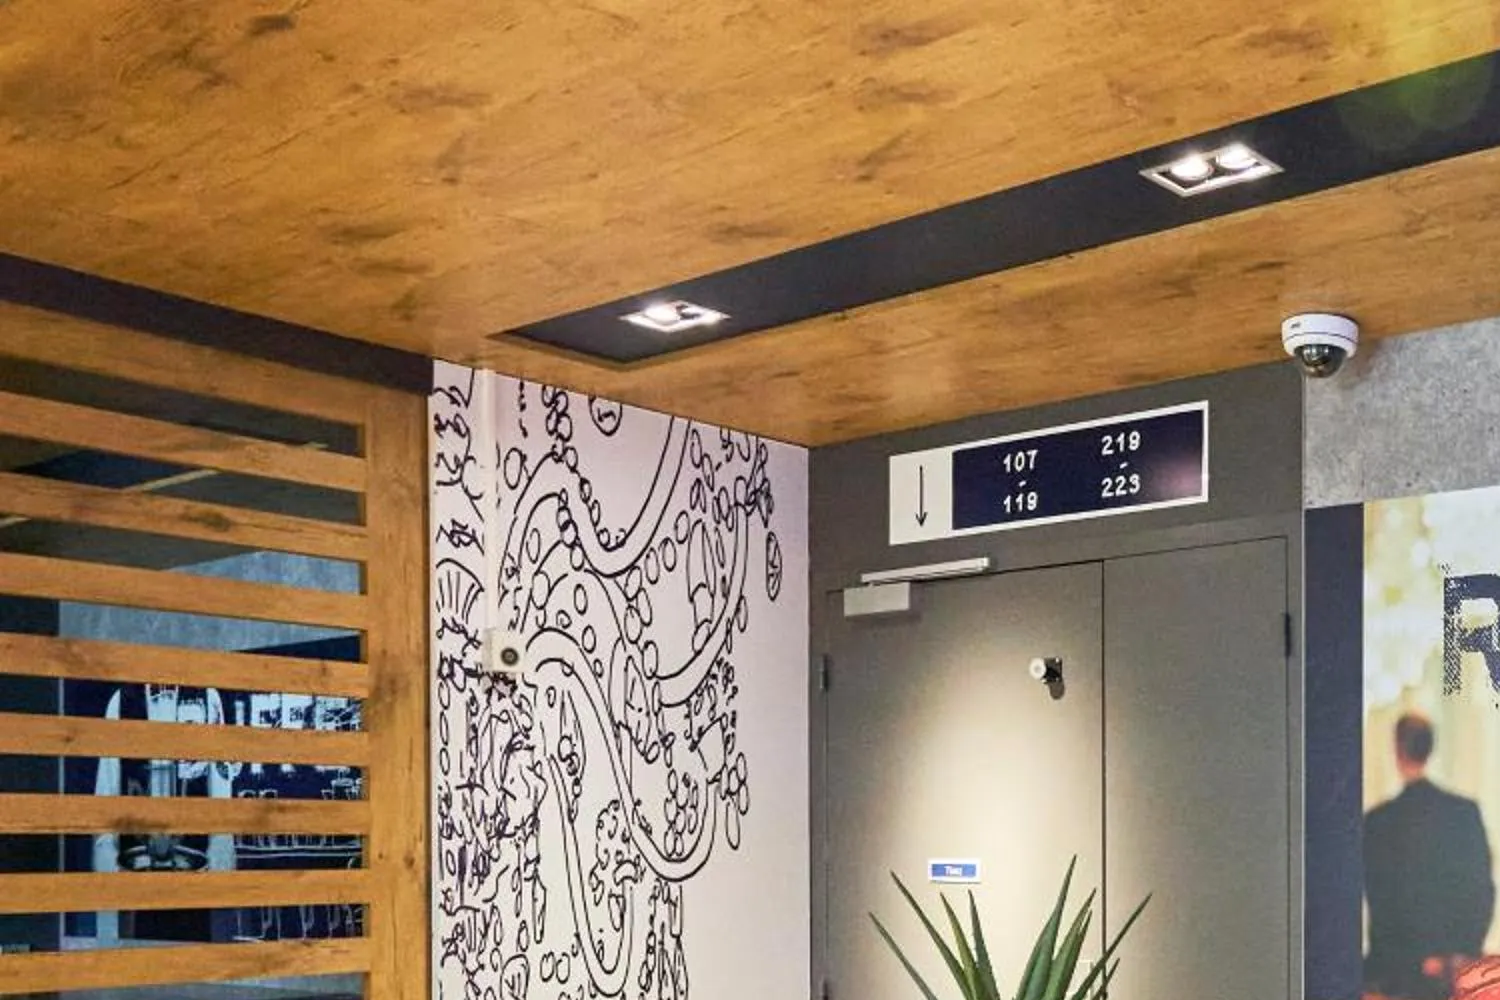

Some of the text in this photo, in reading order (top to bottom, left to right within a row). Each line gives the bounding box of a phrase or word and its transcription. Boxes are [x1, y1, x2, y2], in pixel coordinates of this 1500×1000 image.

[1101, 430, 1141, 456] 219
[1003, 449, 1038, 473] 107
[1101, 473, 1141, 498] 223
[1003, 491, 1038, 513] 119
